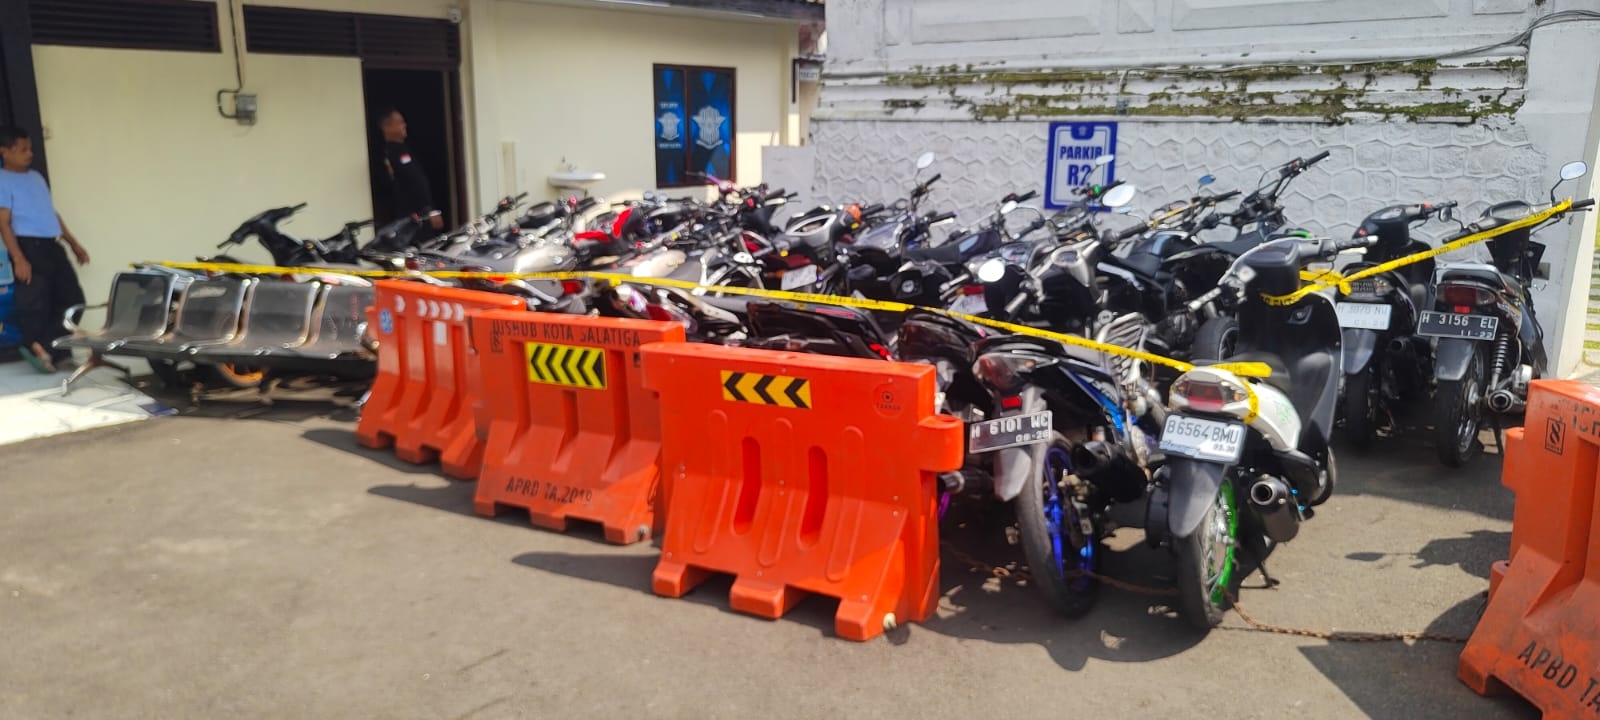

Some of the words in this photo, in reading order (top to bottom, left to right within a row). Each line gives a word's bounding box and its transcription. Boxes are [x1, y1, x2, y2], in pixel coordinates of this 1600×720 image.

[1060, 146, 1103, 161] PARKIR
[1067, 164, 1092, 187] R2
[1422, 313, 1430, 324] H
[1438, 313, 1469, 327] 3156
[1480, 317, 1495, 329] EL
[543, 322, 574, 341] KOTA
[580, 325, 641, 346] SALATIGA
[971, 425, 980, 440] H
[990, 417, 1022, 435] 6101
[1167, 420, 1176, 434] B
[1177, 422, 1210, 440] 6564
[1212, 426, 1239, 444] BMU
[1517, 640, 1577, 689] APBD
